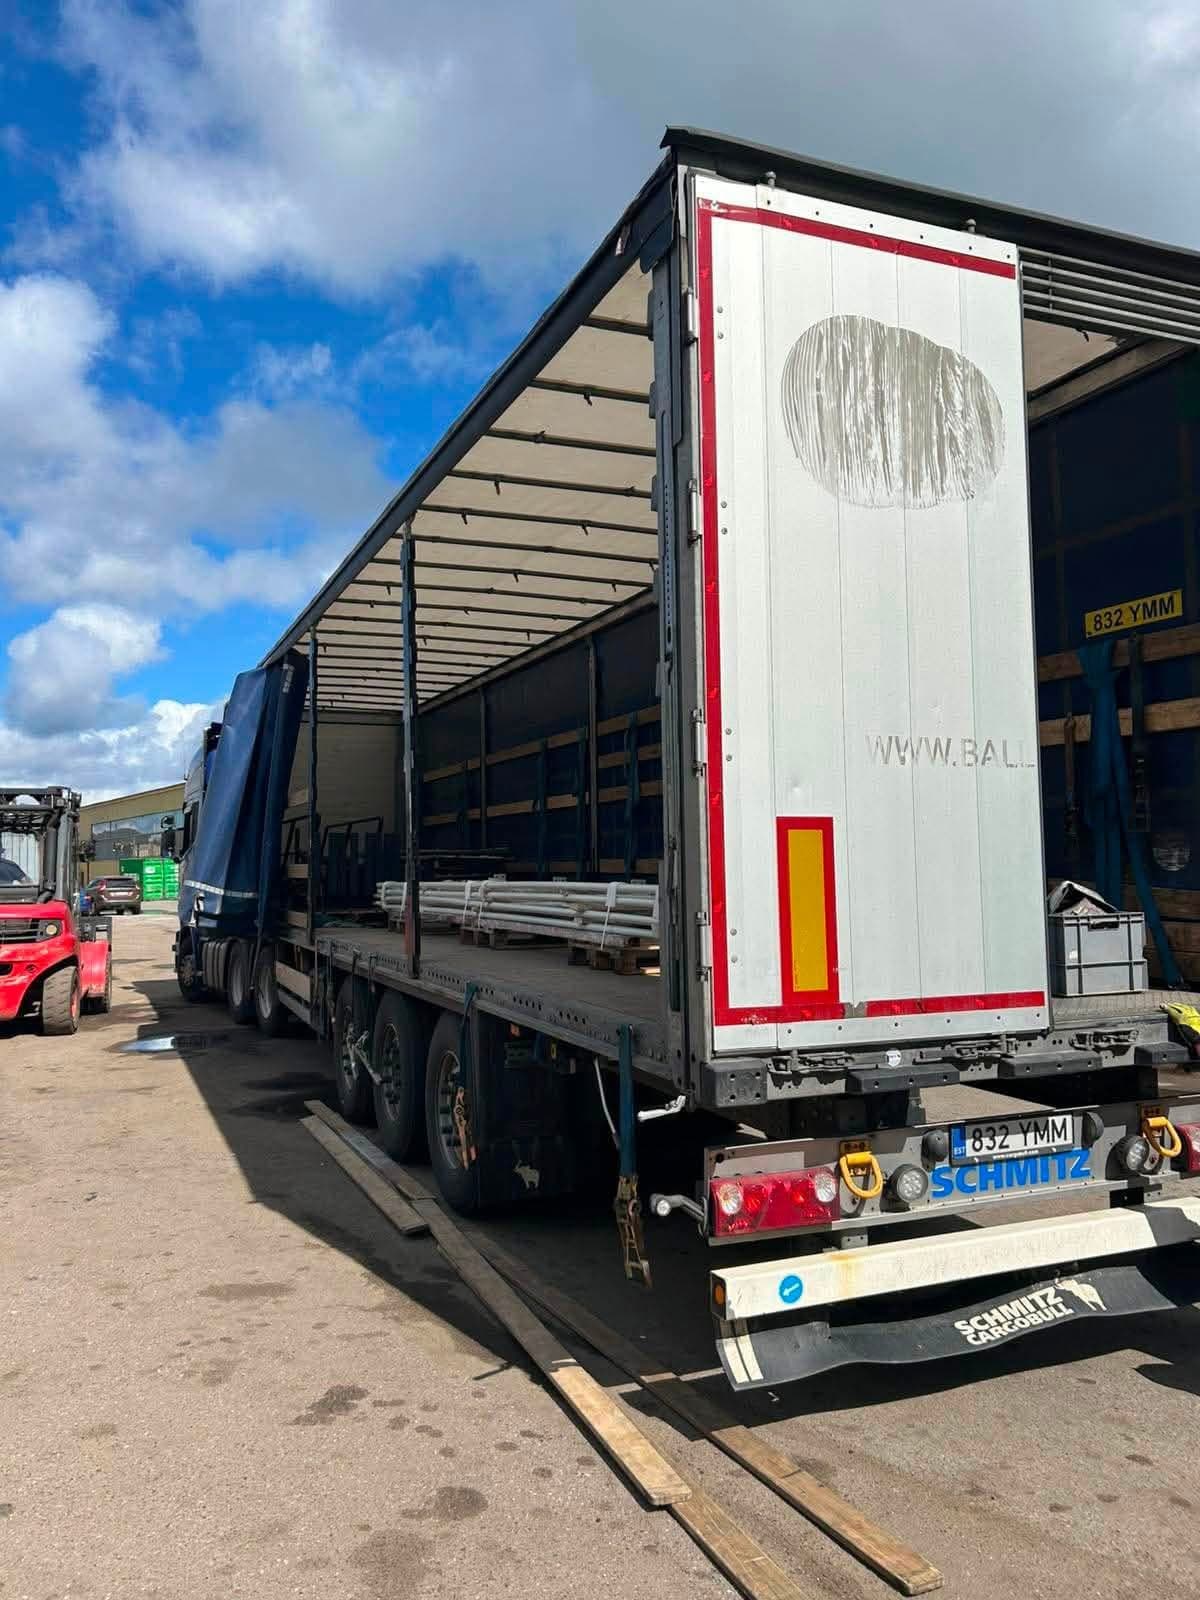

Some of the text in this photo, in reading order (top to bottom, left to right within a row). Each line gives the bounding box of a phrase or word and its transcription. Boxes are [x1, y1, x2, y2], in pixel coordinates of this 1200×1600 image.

[1094, 595, 1174, 632] 832 YMM
[972, 1117, 1067, 1152] 832 YMM
[931, 1148, 1091, 1198] SCHMITZ
[954, 1287, 1063, 1335] SCHMITZ
[966, 1303, 1074, 1345] CARGOBULL
